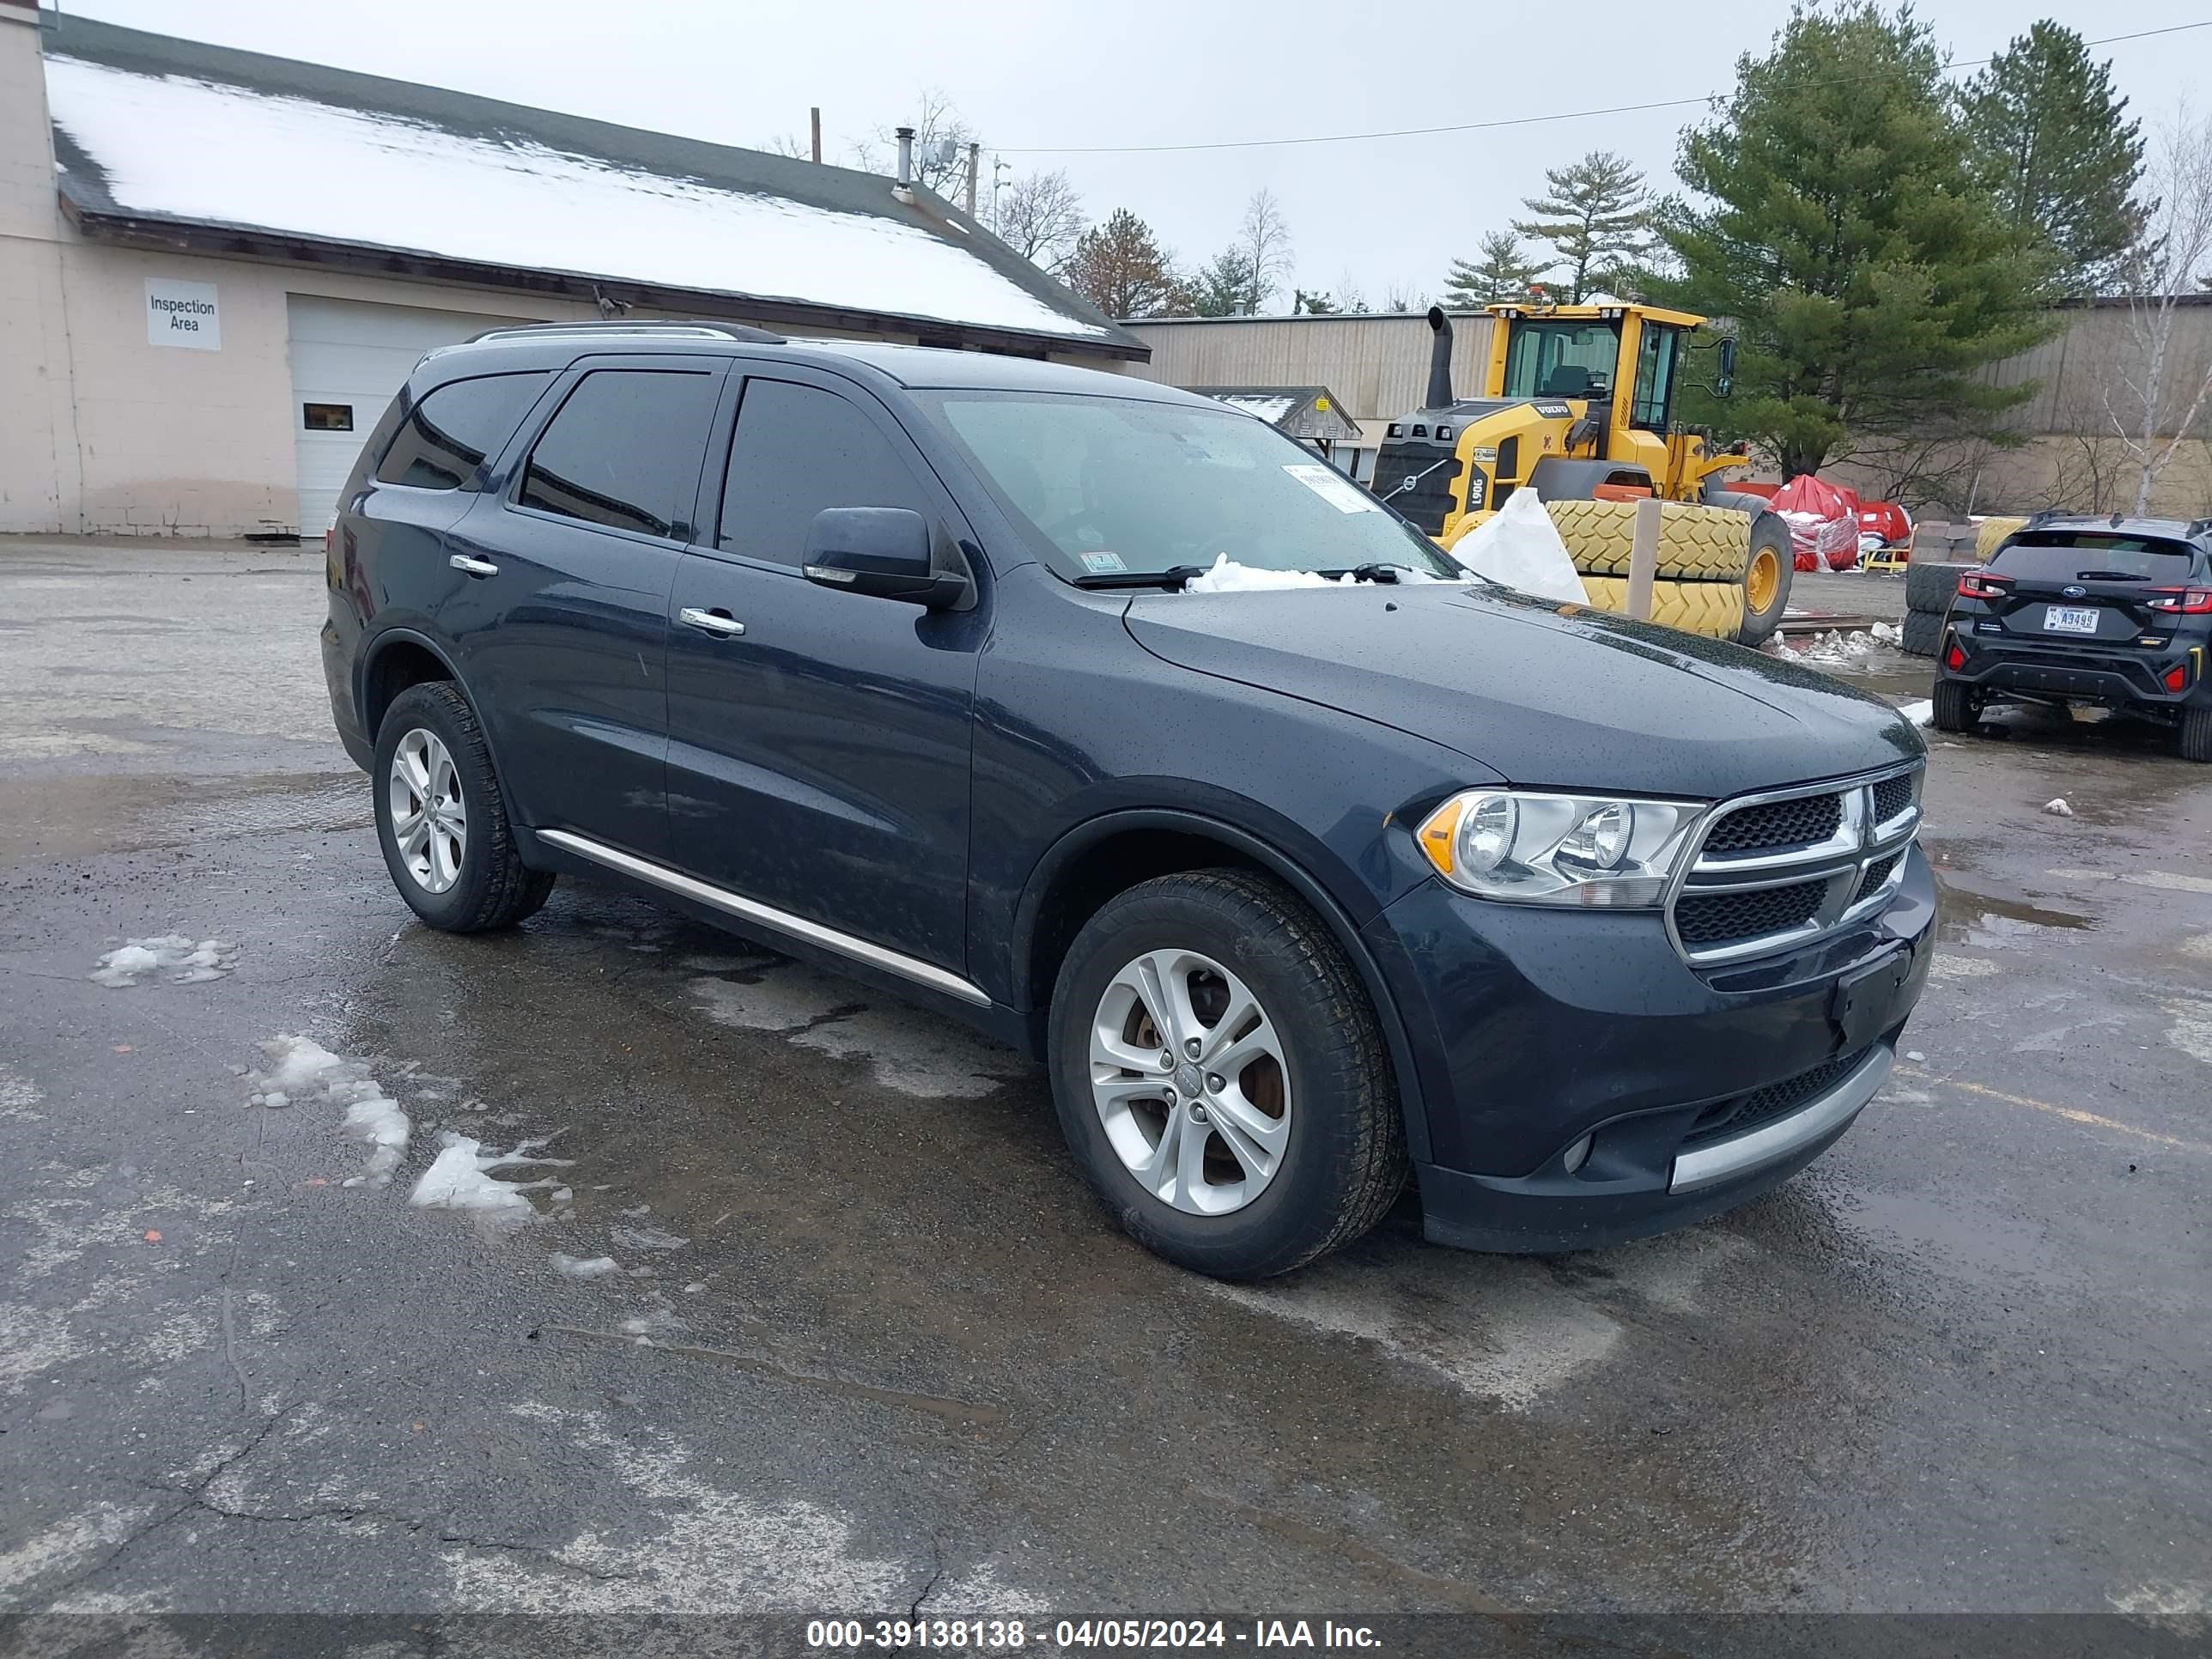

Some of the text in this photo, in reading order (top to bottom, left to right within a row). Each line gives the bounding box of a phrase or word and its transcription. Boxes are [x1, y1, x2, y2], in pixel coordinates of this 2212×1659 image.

[150, 295, 216, 315] Inspection
[170, 315, 199, 331] Area
[1536, 405, 1569, 414] VOLVO
[1472, 478, 1483, 504] L90G
[2061, 612, 2094, 627] A3499
